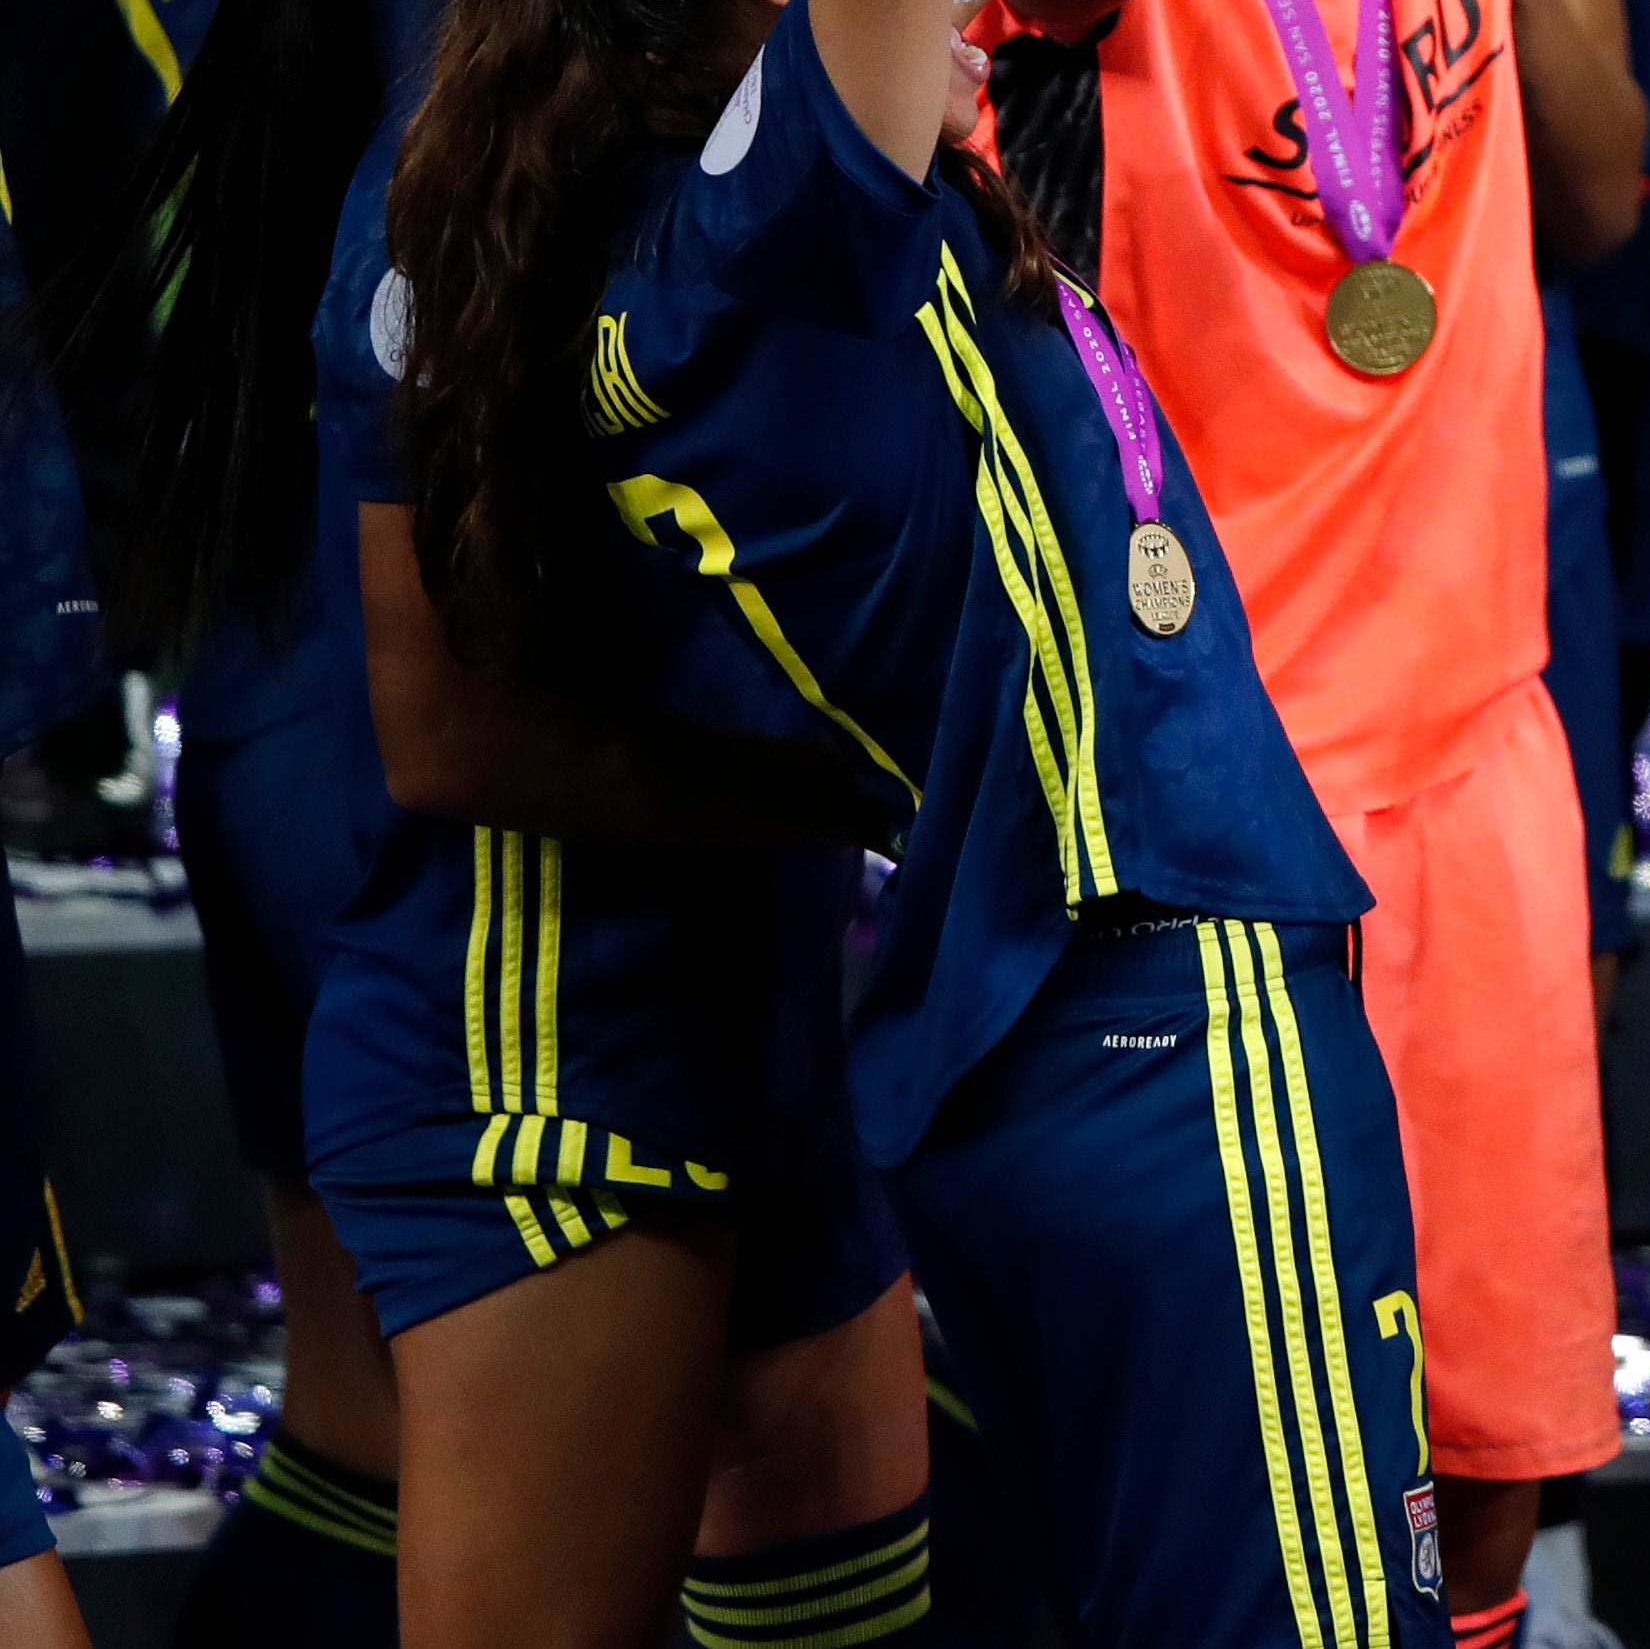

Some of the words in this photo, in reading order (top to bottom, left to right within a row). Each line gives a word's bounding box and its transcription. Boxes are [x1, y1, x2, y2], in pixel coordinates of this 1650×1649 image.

[1083, 326, 1112, 375] 2020
[1110, 381, 1138, 441] FINAL
[1132, 579, 1190, 598] WOMEN'S
[1102, 1034, 1178, 1049] AEROREADY
[1373, 1288, 1429, 1478] 7
